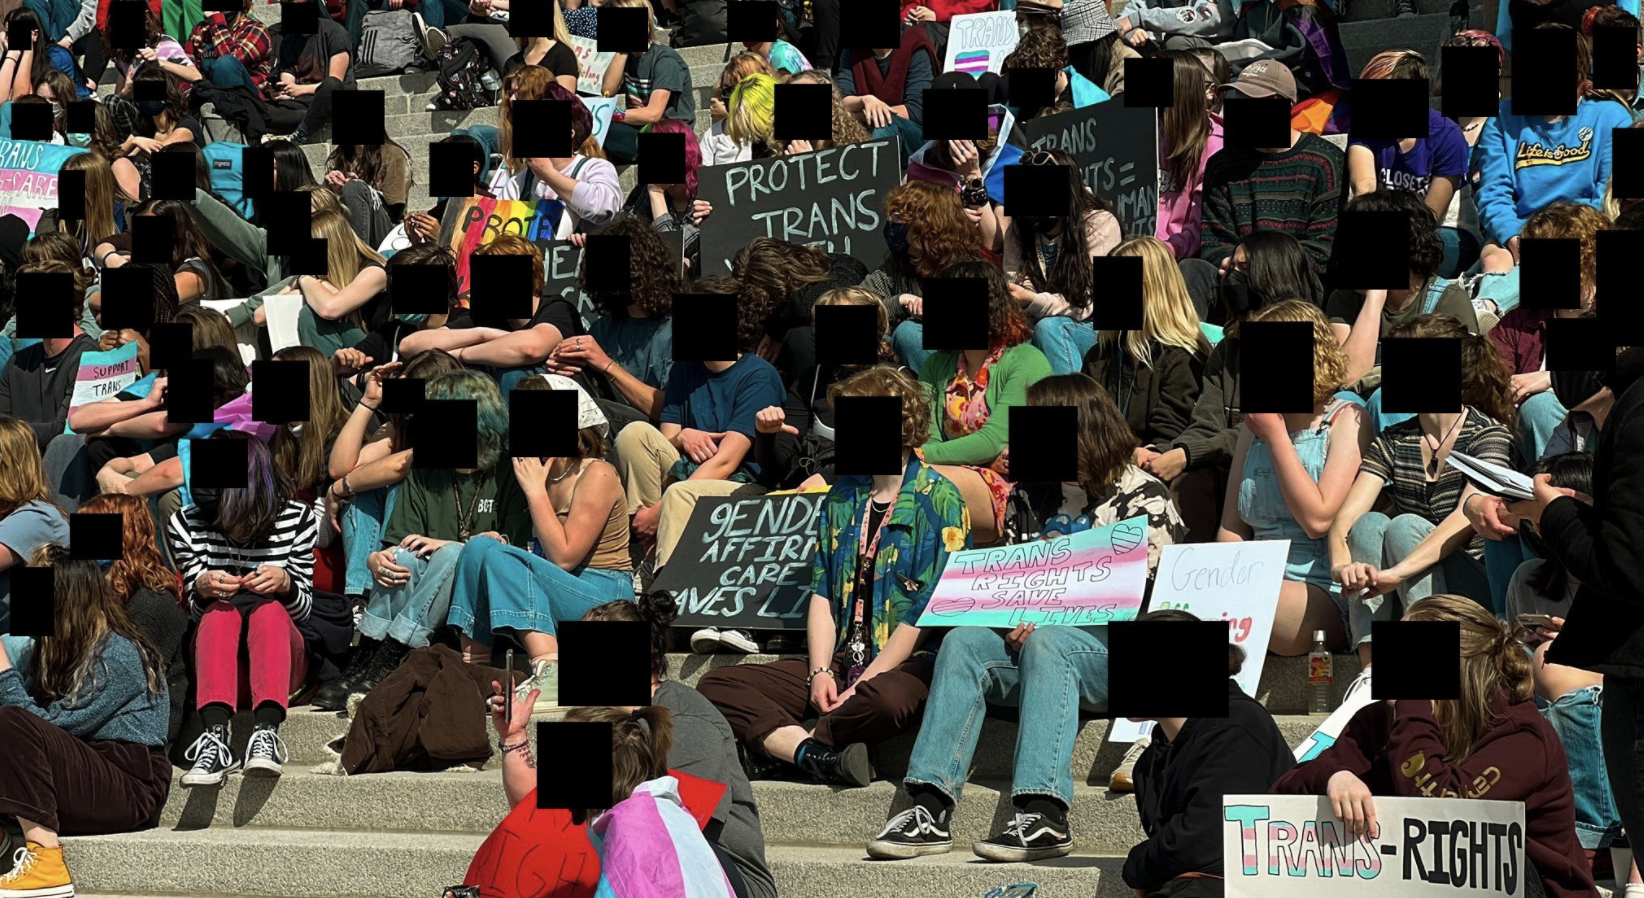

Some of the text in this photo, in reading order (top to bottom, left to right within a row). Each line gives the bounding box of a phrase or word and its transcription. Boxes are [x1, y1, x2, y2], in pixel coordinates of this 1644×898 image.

[956, 16, 1015, 50] TRANS
[0, 141, 44, 170] RANS
[726, 141, 890, 206] PROTECT
[751, 188, 880, 242] TRANS
[1117, 181, 1157, 221] MAN
[461, 206, 552, 240] PROTE
[93, 360, 129, 379] SUPPORT
[91, 381, 122, 397] TRANS
[699, 535, 816, 563] AFFIR
[955, 538, 1072, 575] TRANS
[719, 562, 807, 587] CARE
[971, 556, 1112, 591] RIGHTS
[1171, 547, 1264, 592] Gender
[981, 587, 1067, 609] SAVE
[1008, 603, 1117, 626] LIVES
[1224, 804, 1523, 896] TRANS-RIGHTS
